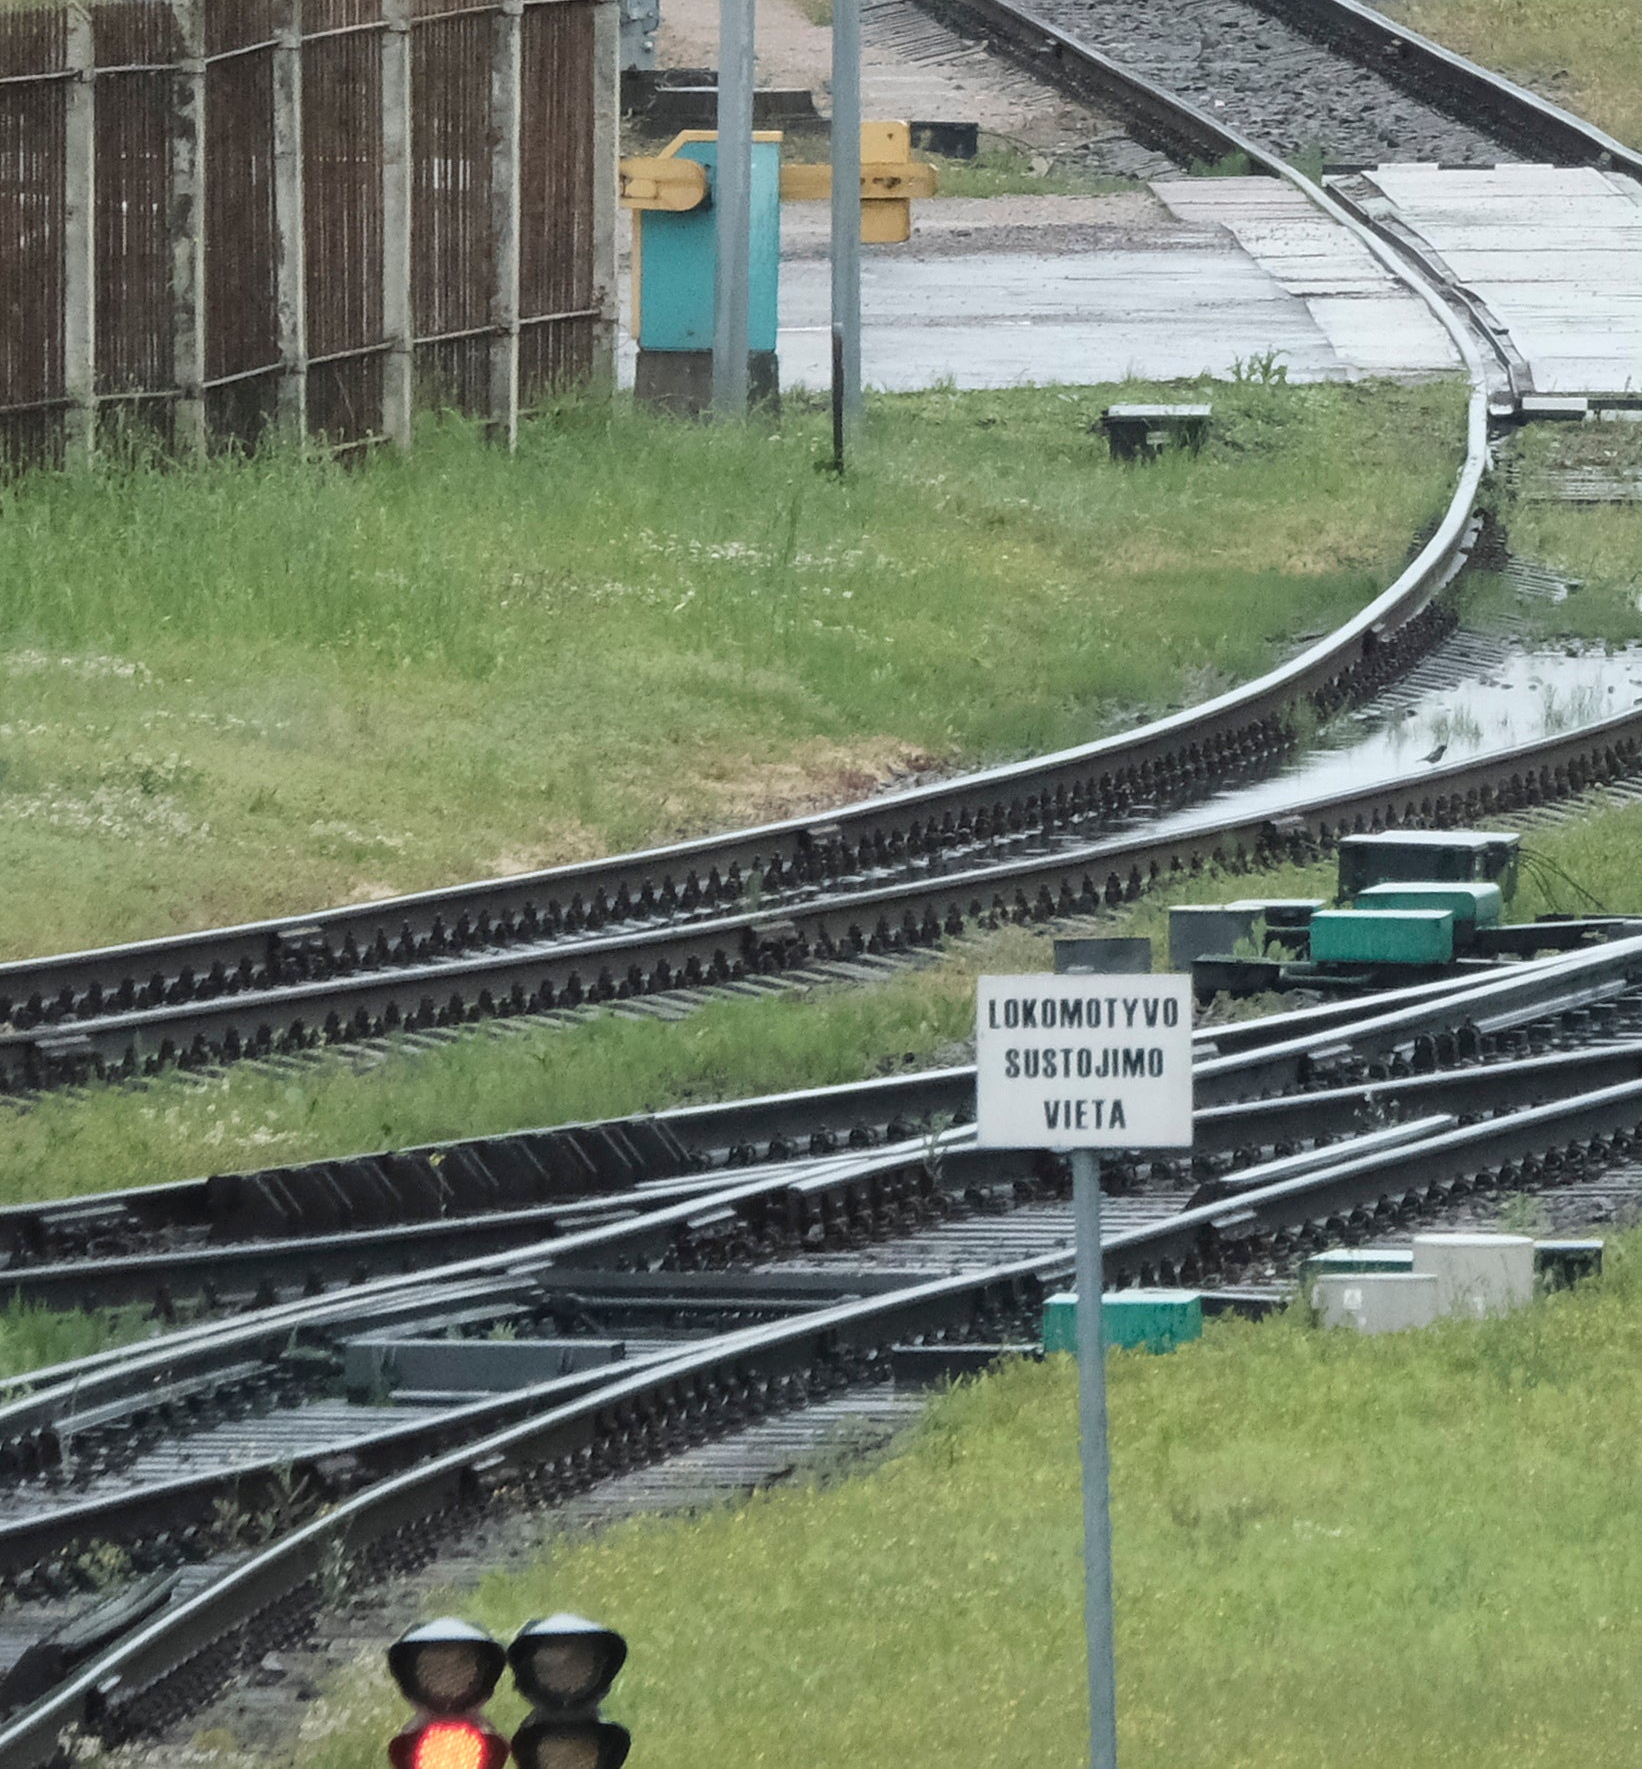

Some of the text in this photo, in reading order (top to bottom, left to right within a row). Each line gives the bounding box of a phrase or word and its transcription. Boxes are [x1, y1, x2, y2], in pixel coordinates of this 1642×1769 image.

[988, 996, 1179, 1029] LOKOMOTYVO
[1004, 1047, 1165, 1079] SUSTOJIMO
[1043, 1098, 1127, 1130] VIETA
